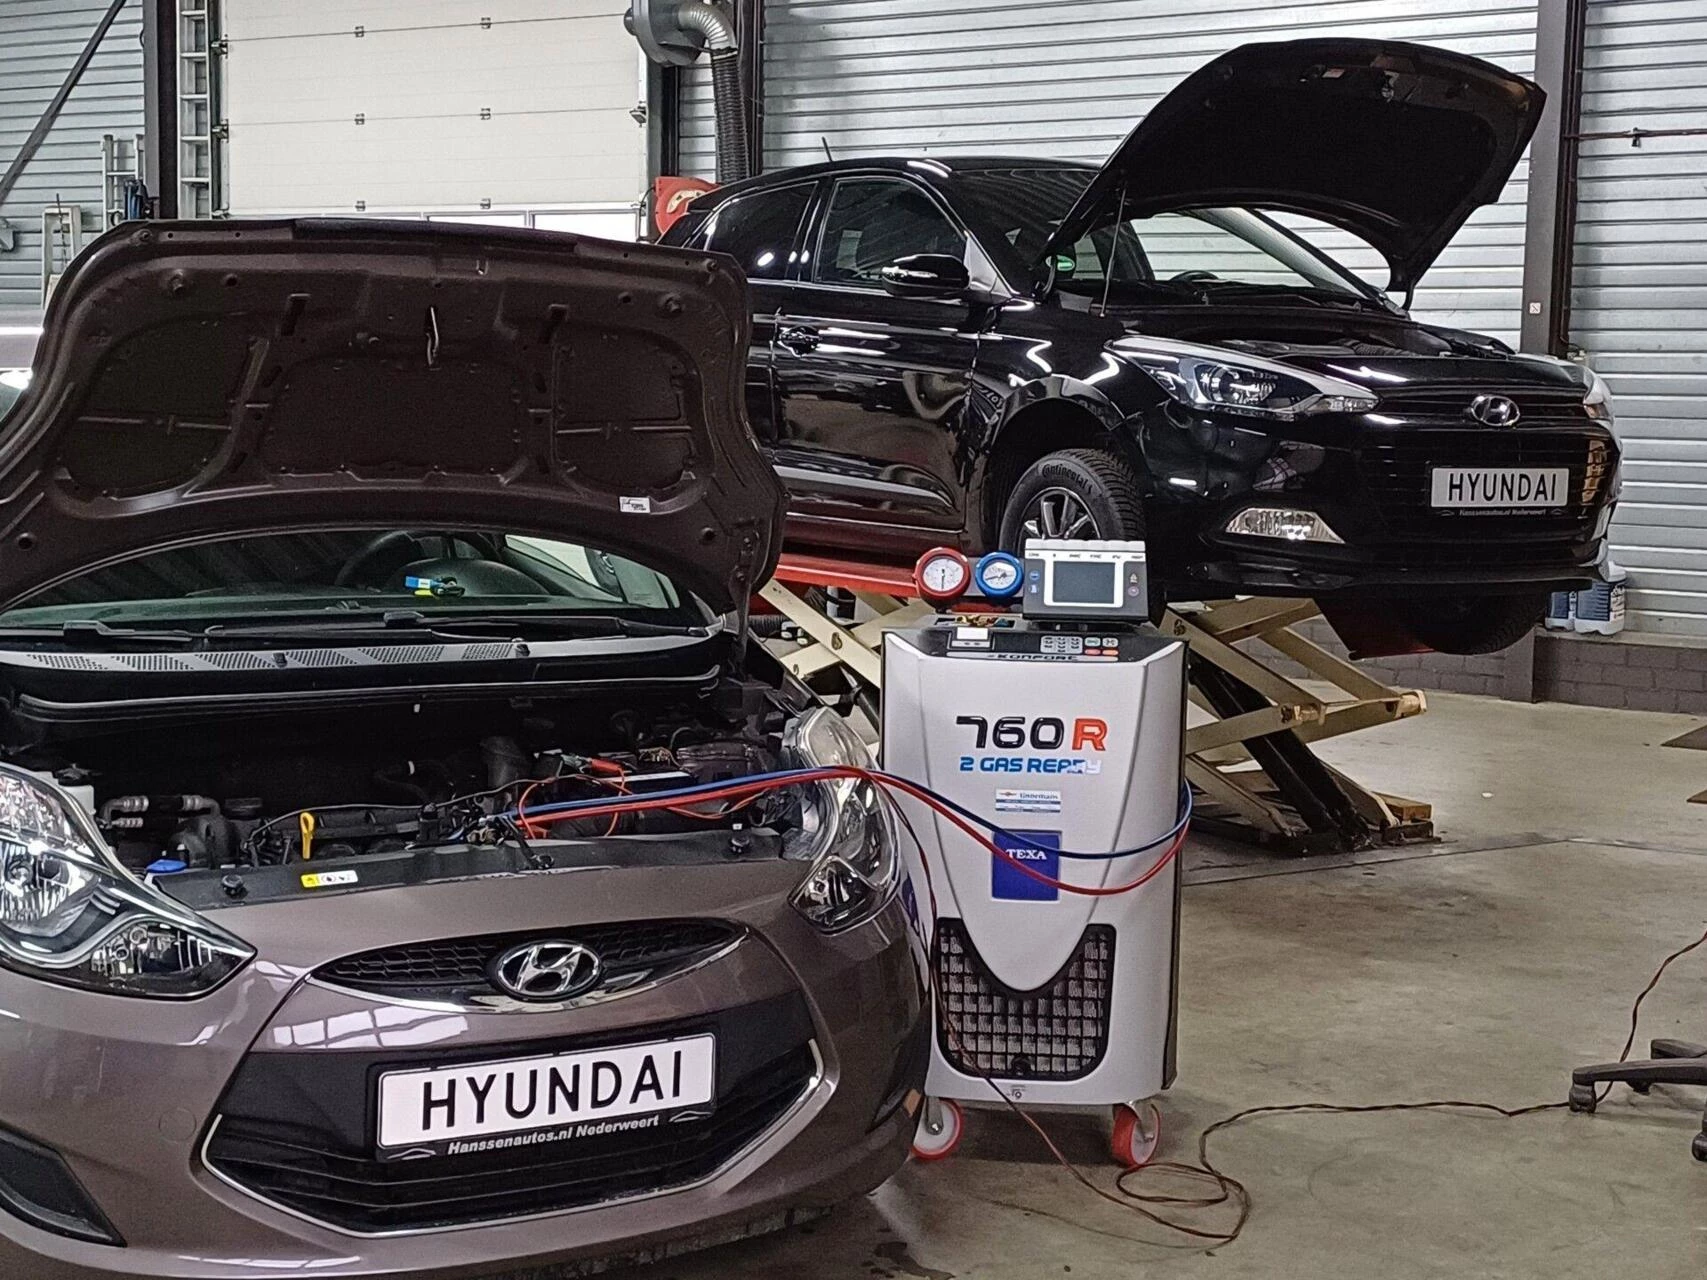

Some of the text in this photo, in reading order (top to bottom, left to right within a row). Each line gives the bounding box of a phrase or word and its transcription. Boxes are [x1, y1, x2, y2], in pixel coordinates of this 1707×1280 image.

[1041, 463, 1089, 489] Continental
[1448, 473, 1557, 502] HYUNDAI
[959, 756, 1101, 774] 2 GAS REAY
[1006, 849, 1048, 860] TEXA
[421, 1049, 682, 1131] HYUNDAI
[447, 1114, 660, 1155] Hanssenautos.nl Nederweert
